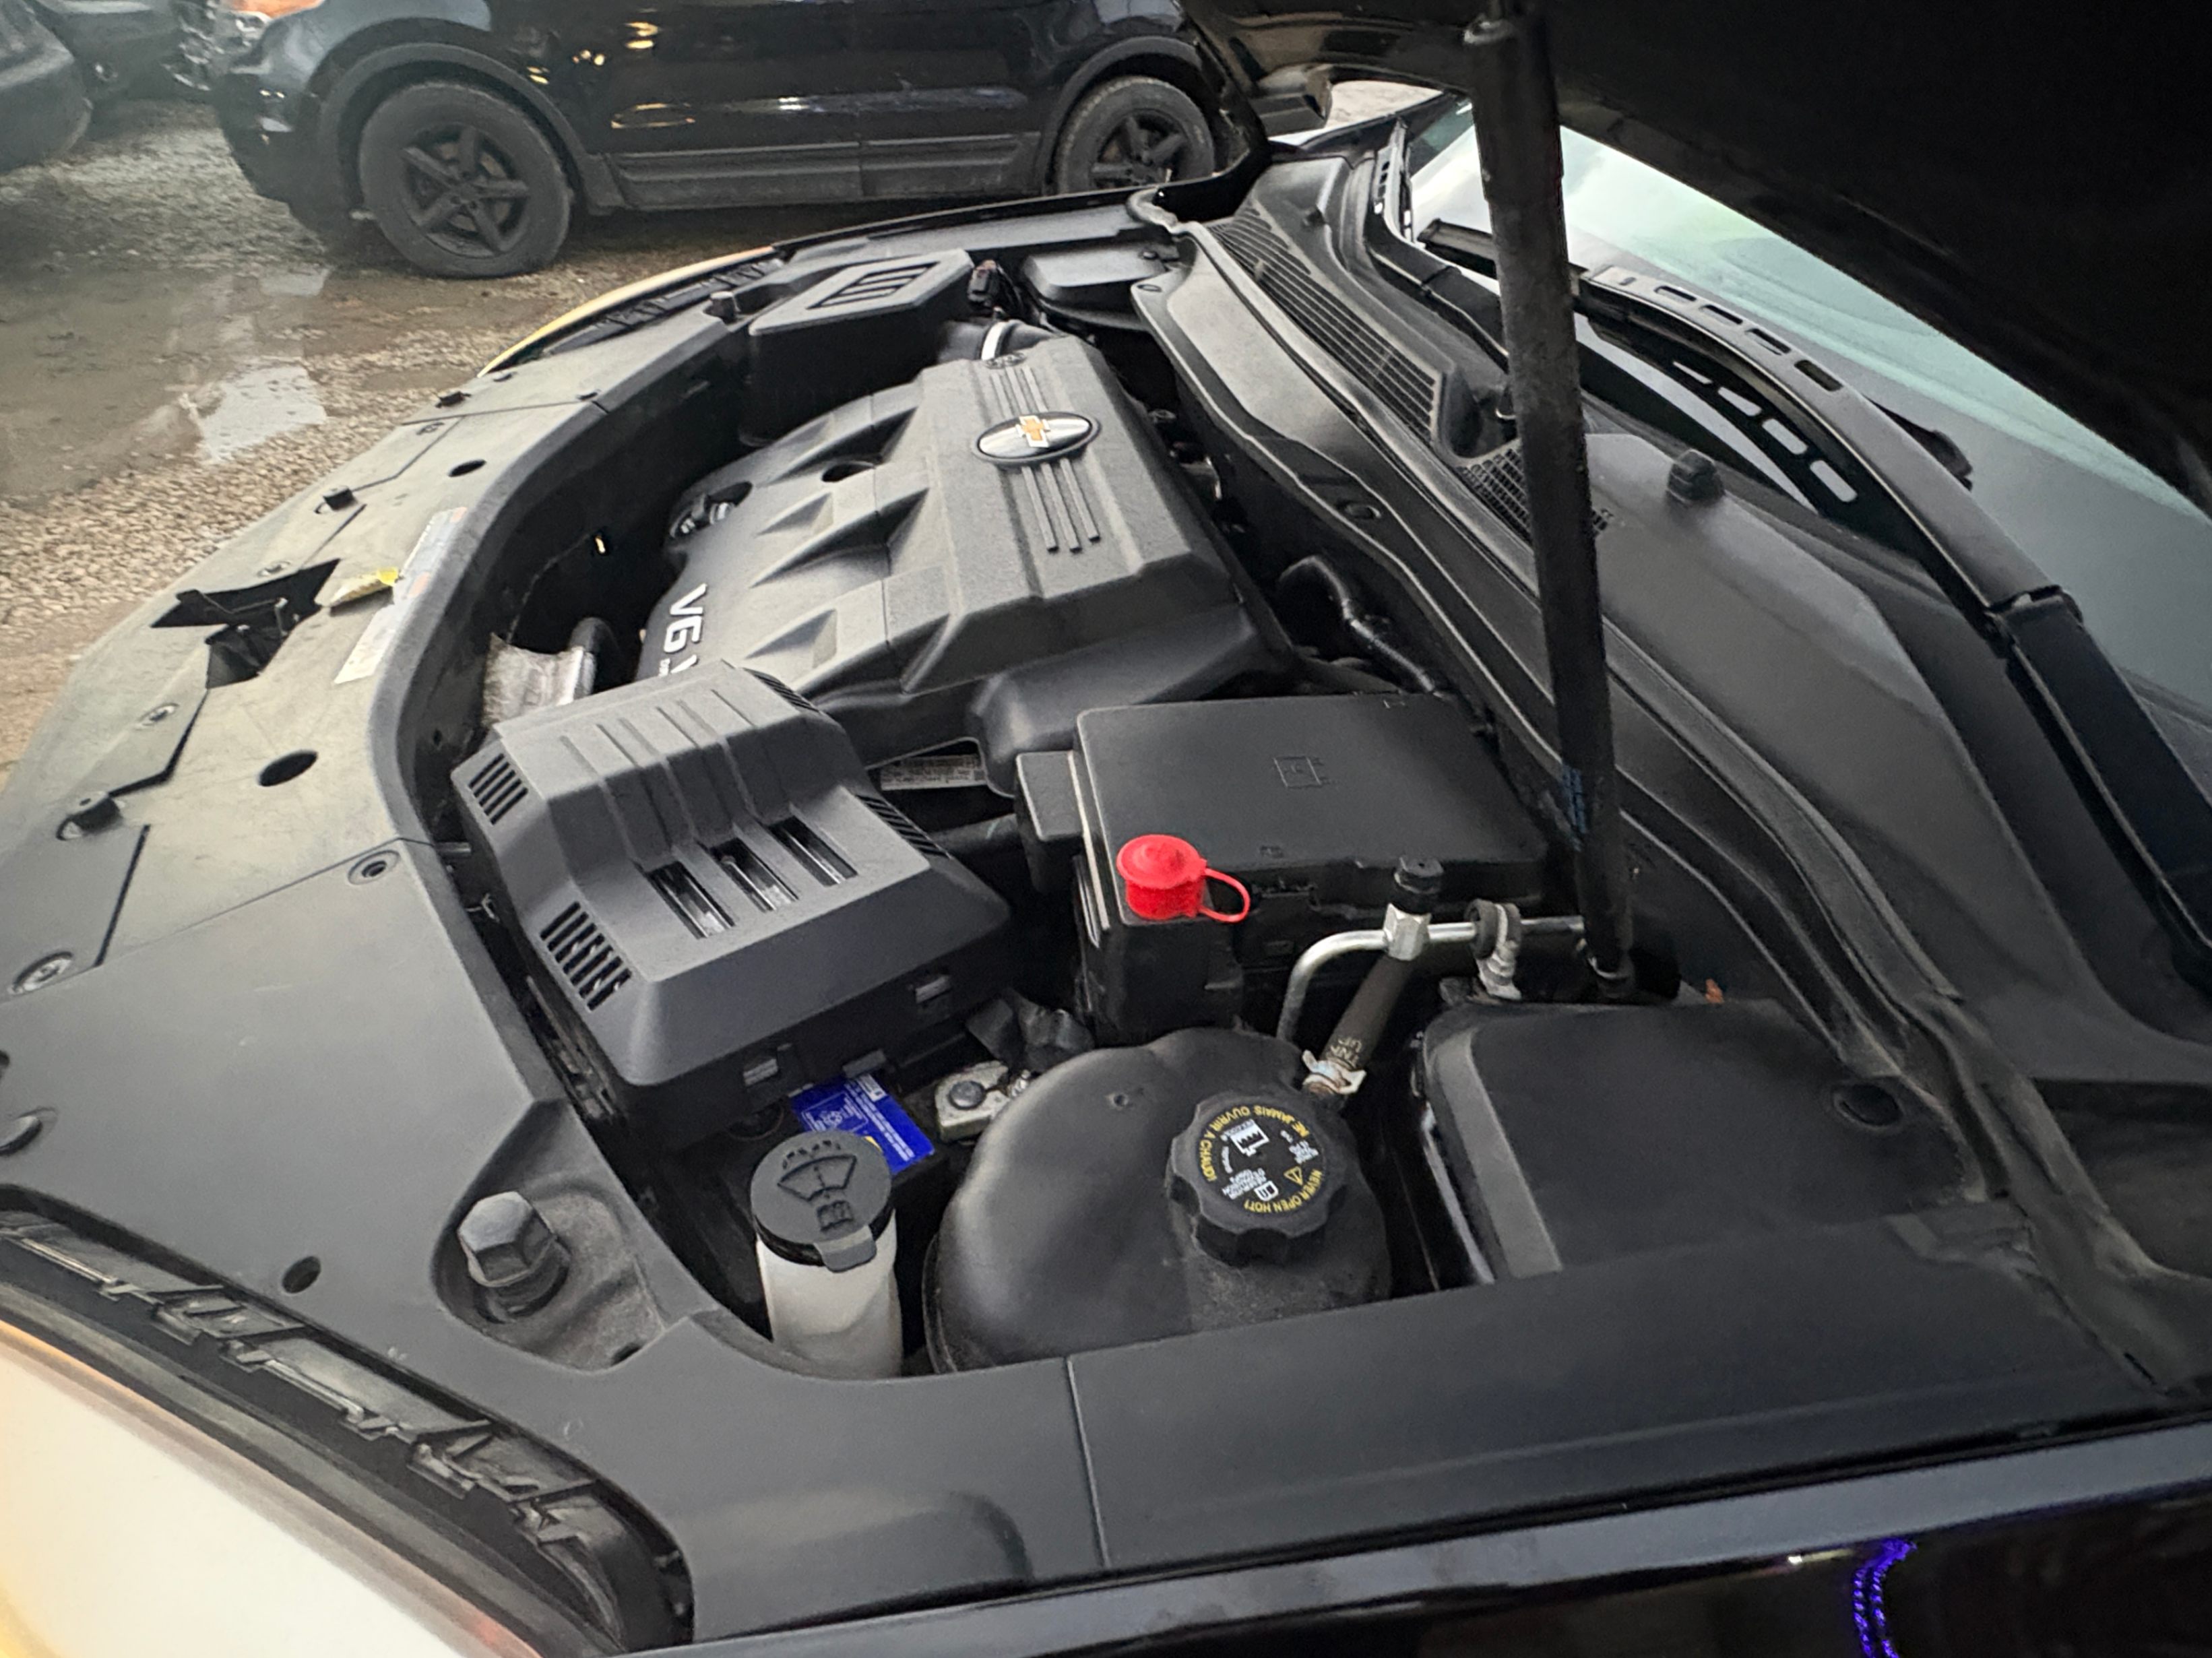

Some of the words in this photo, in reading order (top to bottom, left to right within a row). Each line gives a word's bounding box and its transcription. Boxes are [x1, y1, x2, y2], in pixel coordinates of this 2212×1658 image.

[664, 583, 707, 653] V6
[1209, 1106, 1251, 1132] OUVRIR
[1253, 1105, 1296, 1124] JAMAIS
[1300, 1168, 1323, 1200] NEVER
[1273, 1196, 1302, 1213] OPEN
